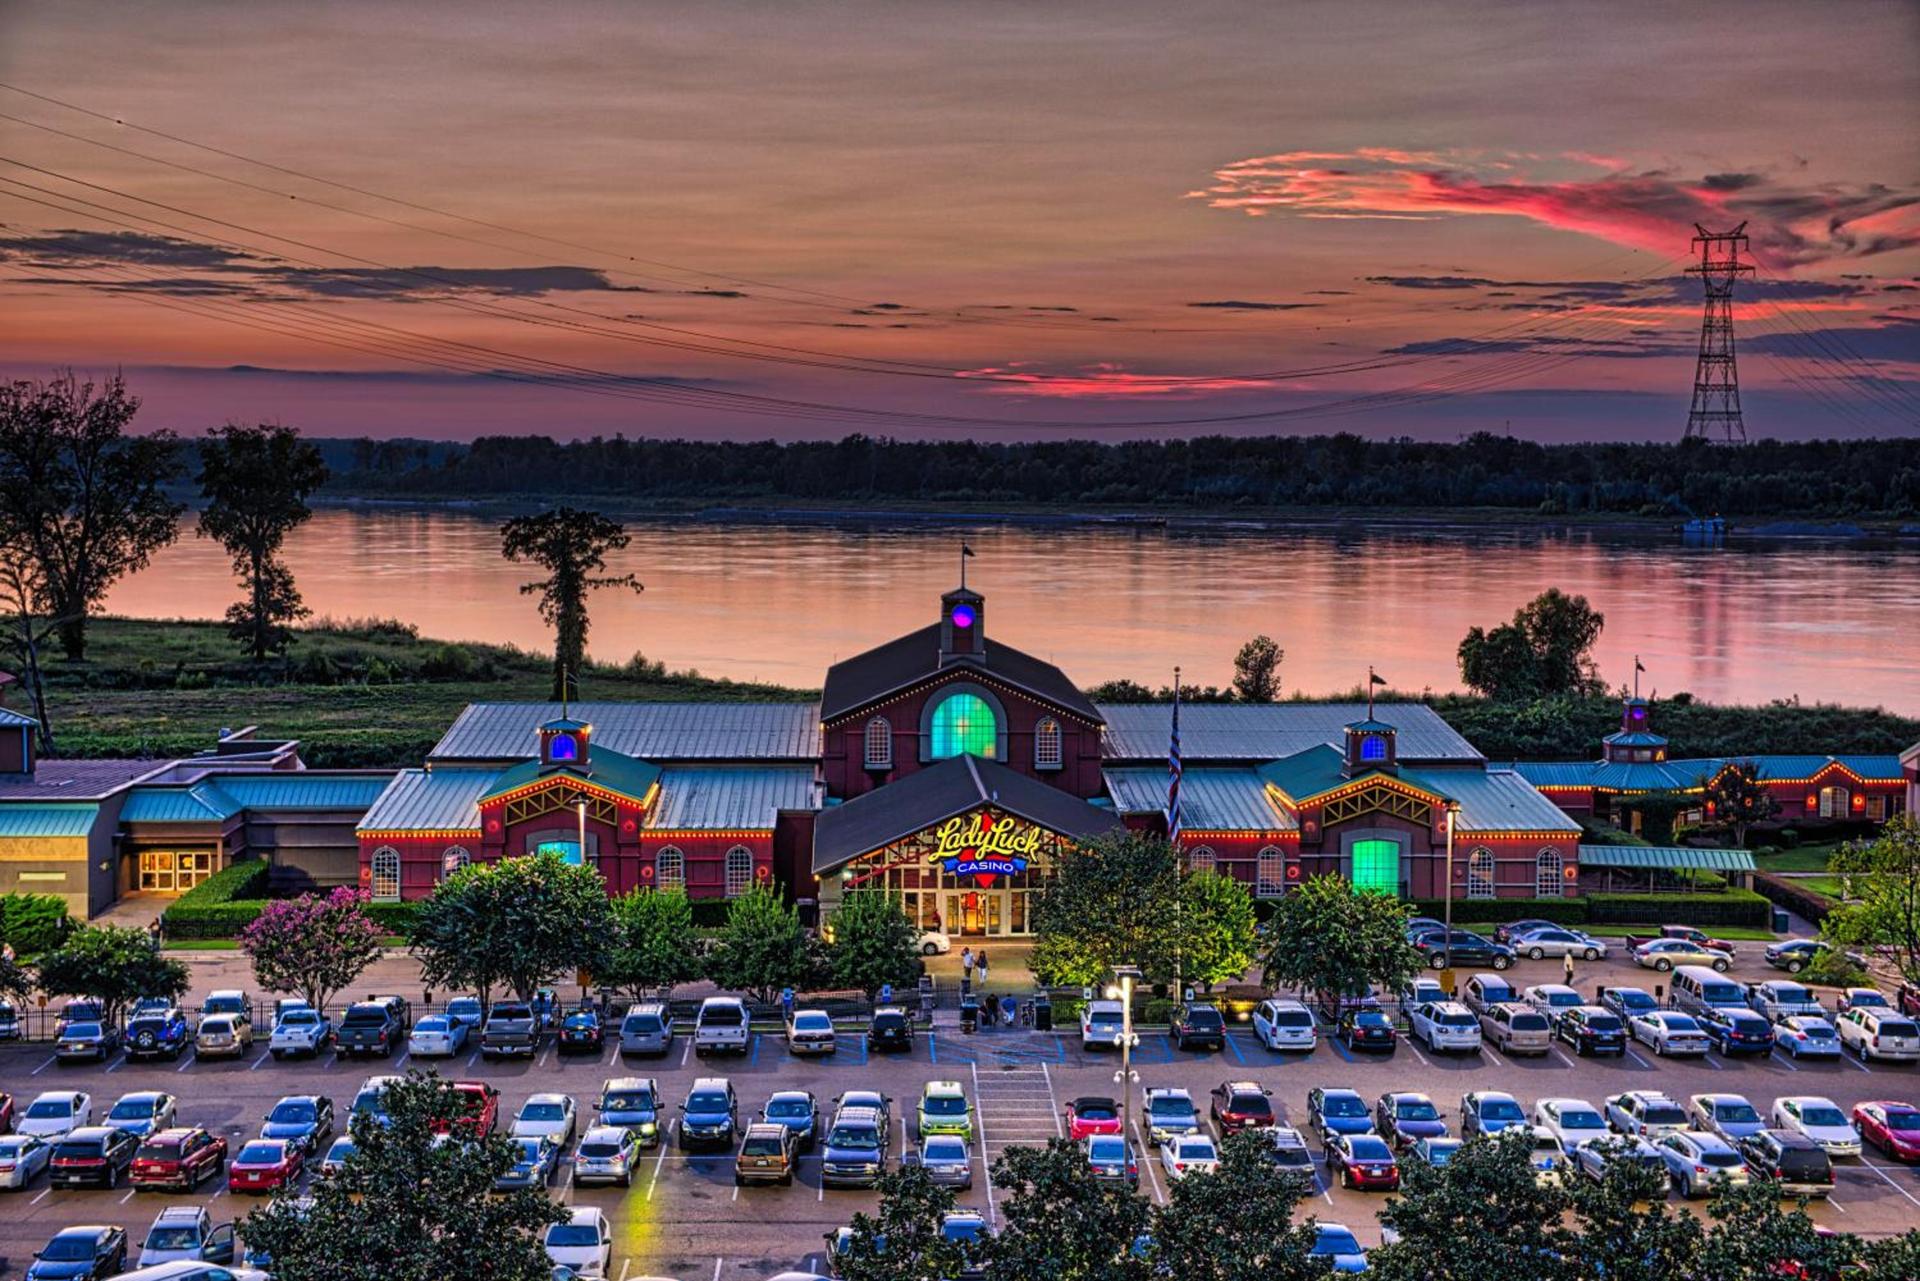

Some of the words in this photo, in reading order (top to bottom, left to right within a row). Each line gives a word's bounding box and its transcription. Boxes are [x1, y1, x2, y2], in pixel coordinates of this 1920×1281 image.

[928, 815, 988, 863] Lady
[988, 816, 1041, 863] Luck
[957, 861, 1014, 873] CASINO
